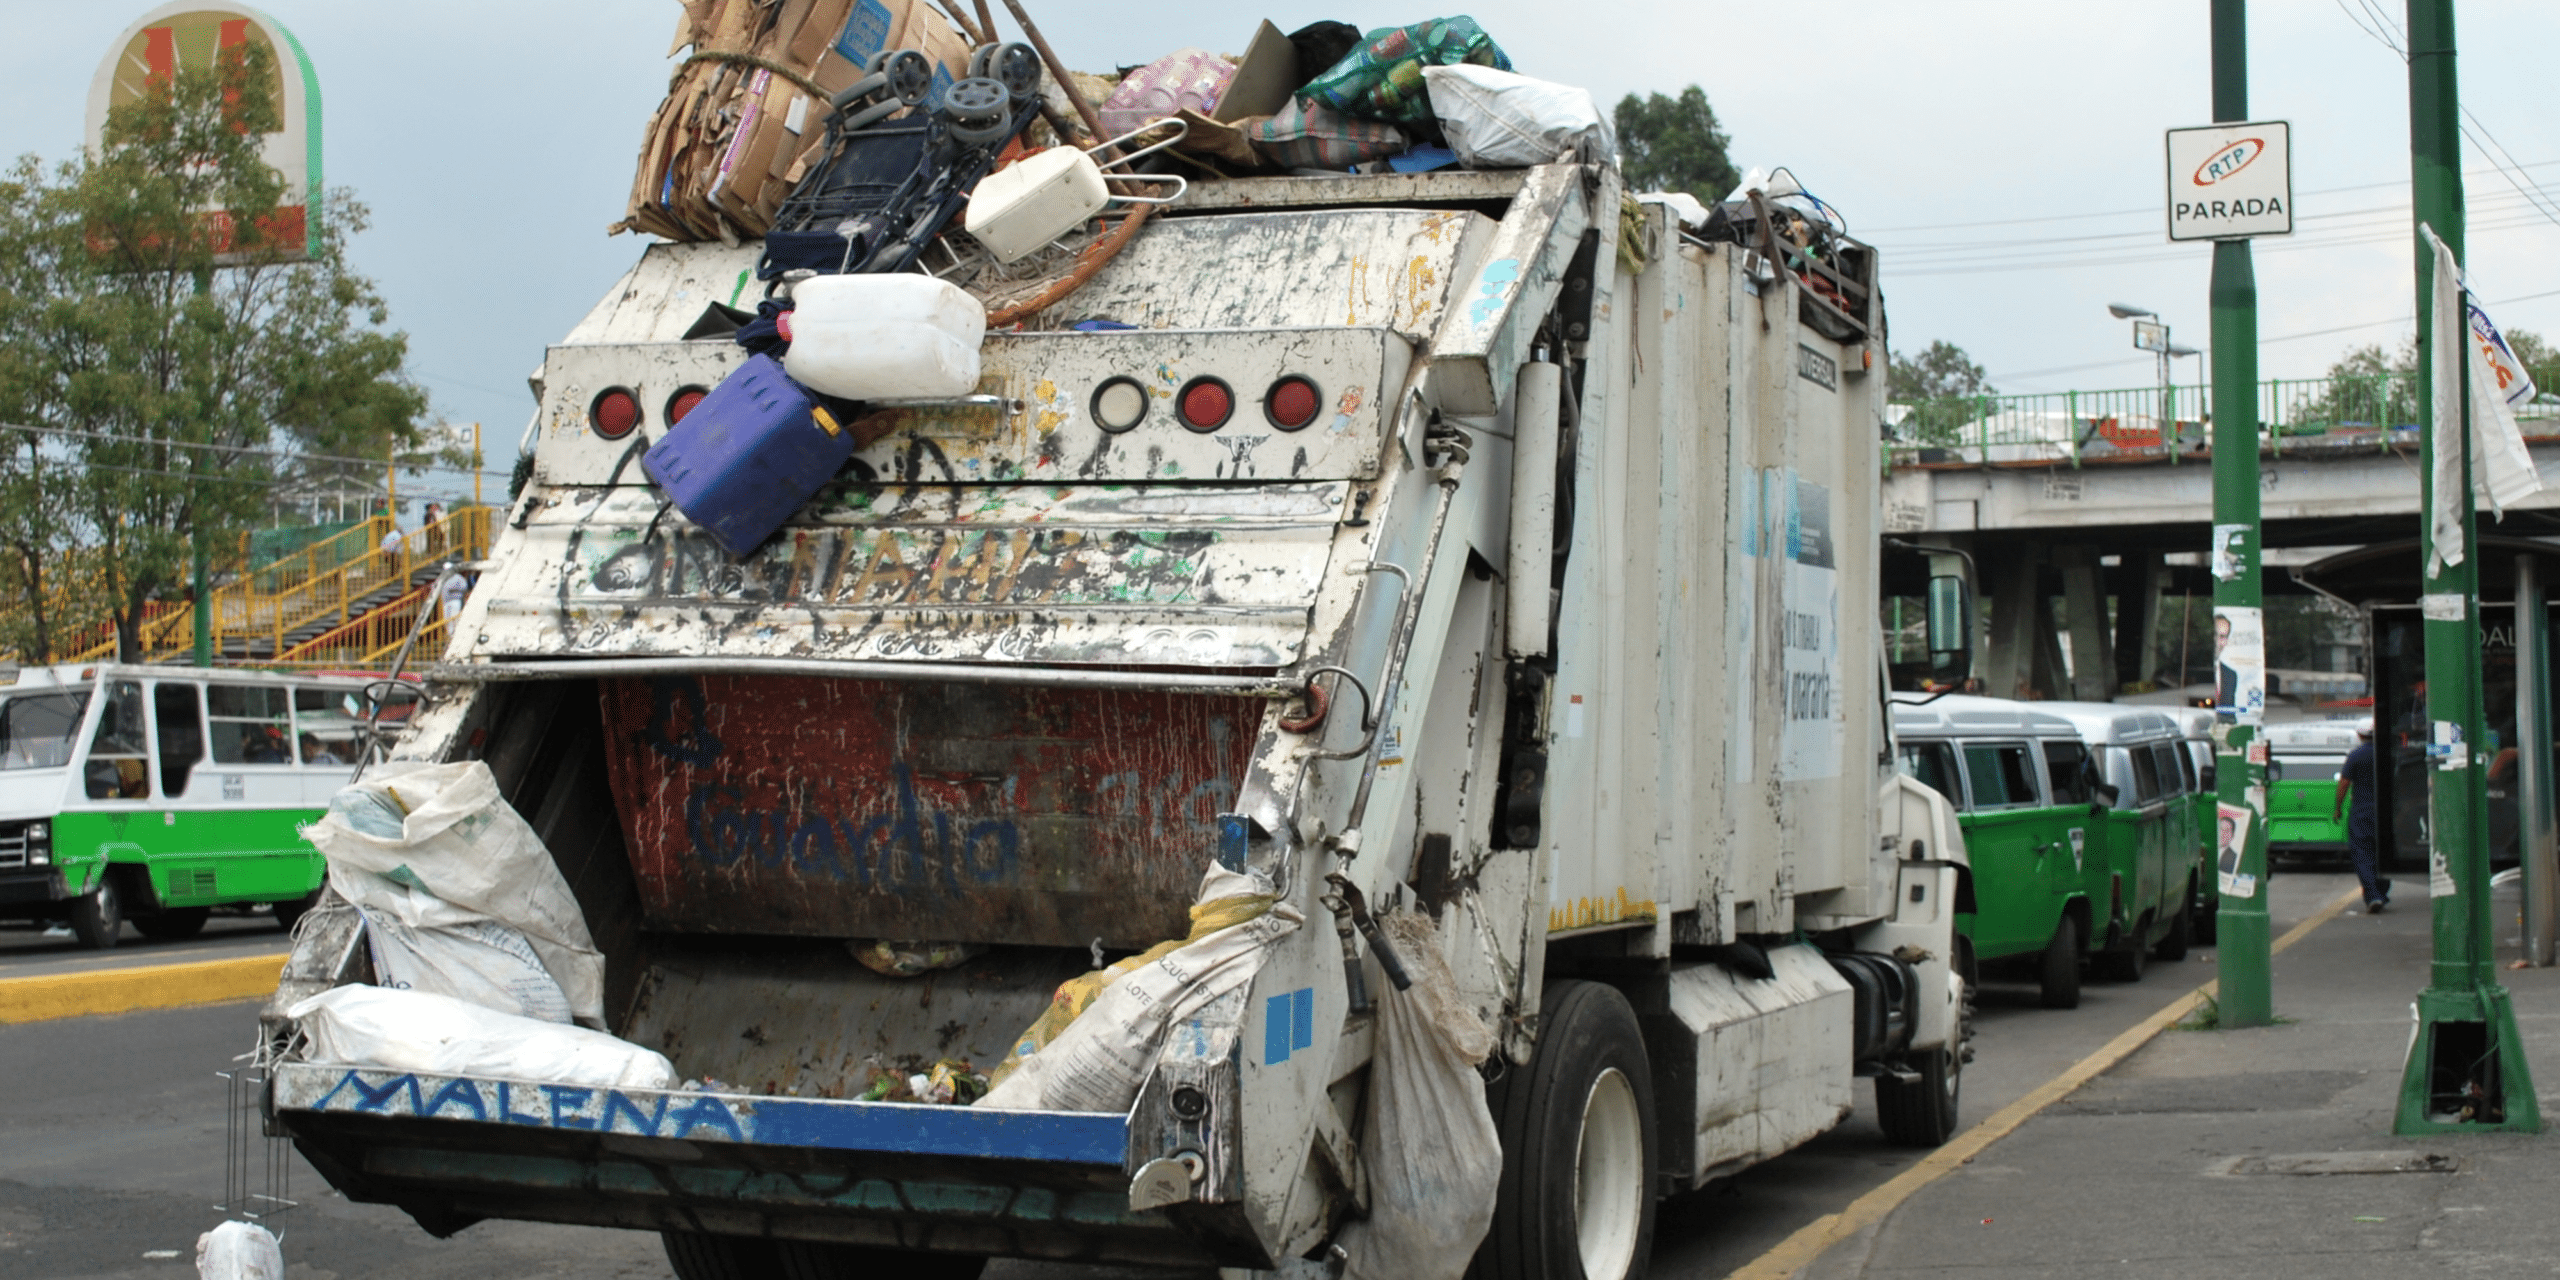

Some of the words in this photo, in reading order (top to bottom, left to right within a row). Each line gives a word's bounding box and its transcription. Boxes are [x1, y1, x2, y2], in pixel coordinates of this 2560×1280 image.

[2208, 147, 2244, 179] RTP
[2176, 197, 2283, 221] PARADA
[1125, 980, 1153, 1006] LOTE
[311, 1068, 744, 1143] MALENA
